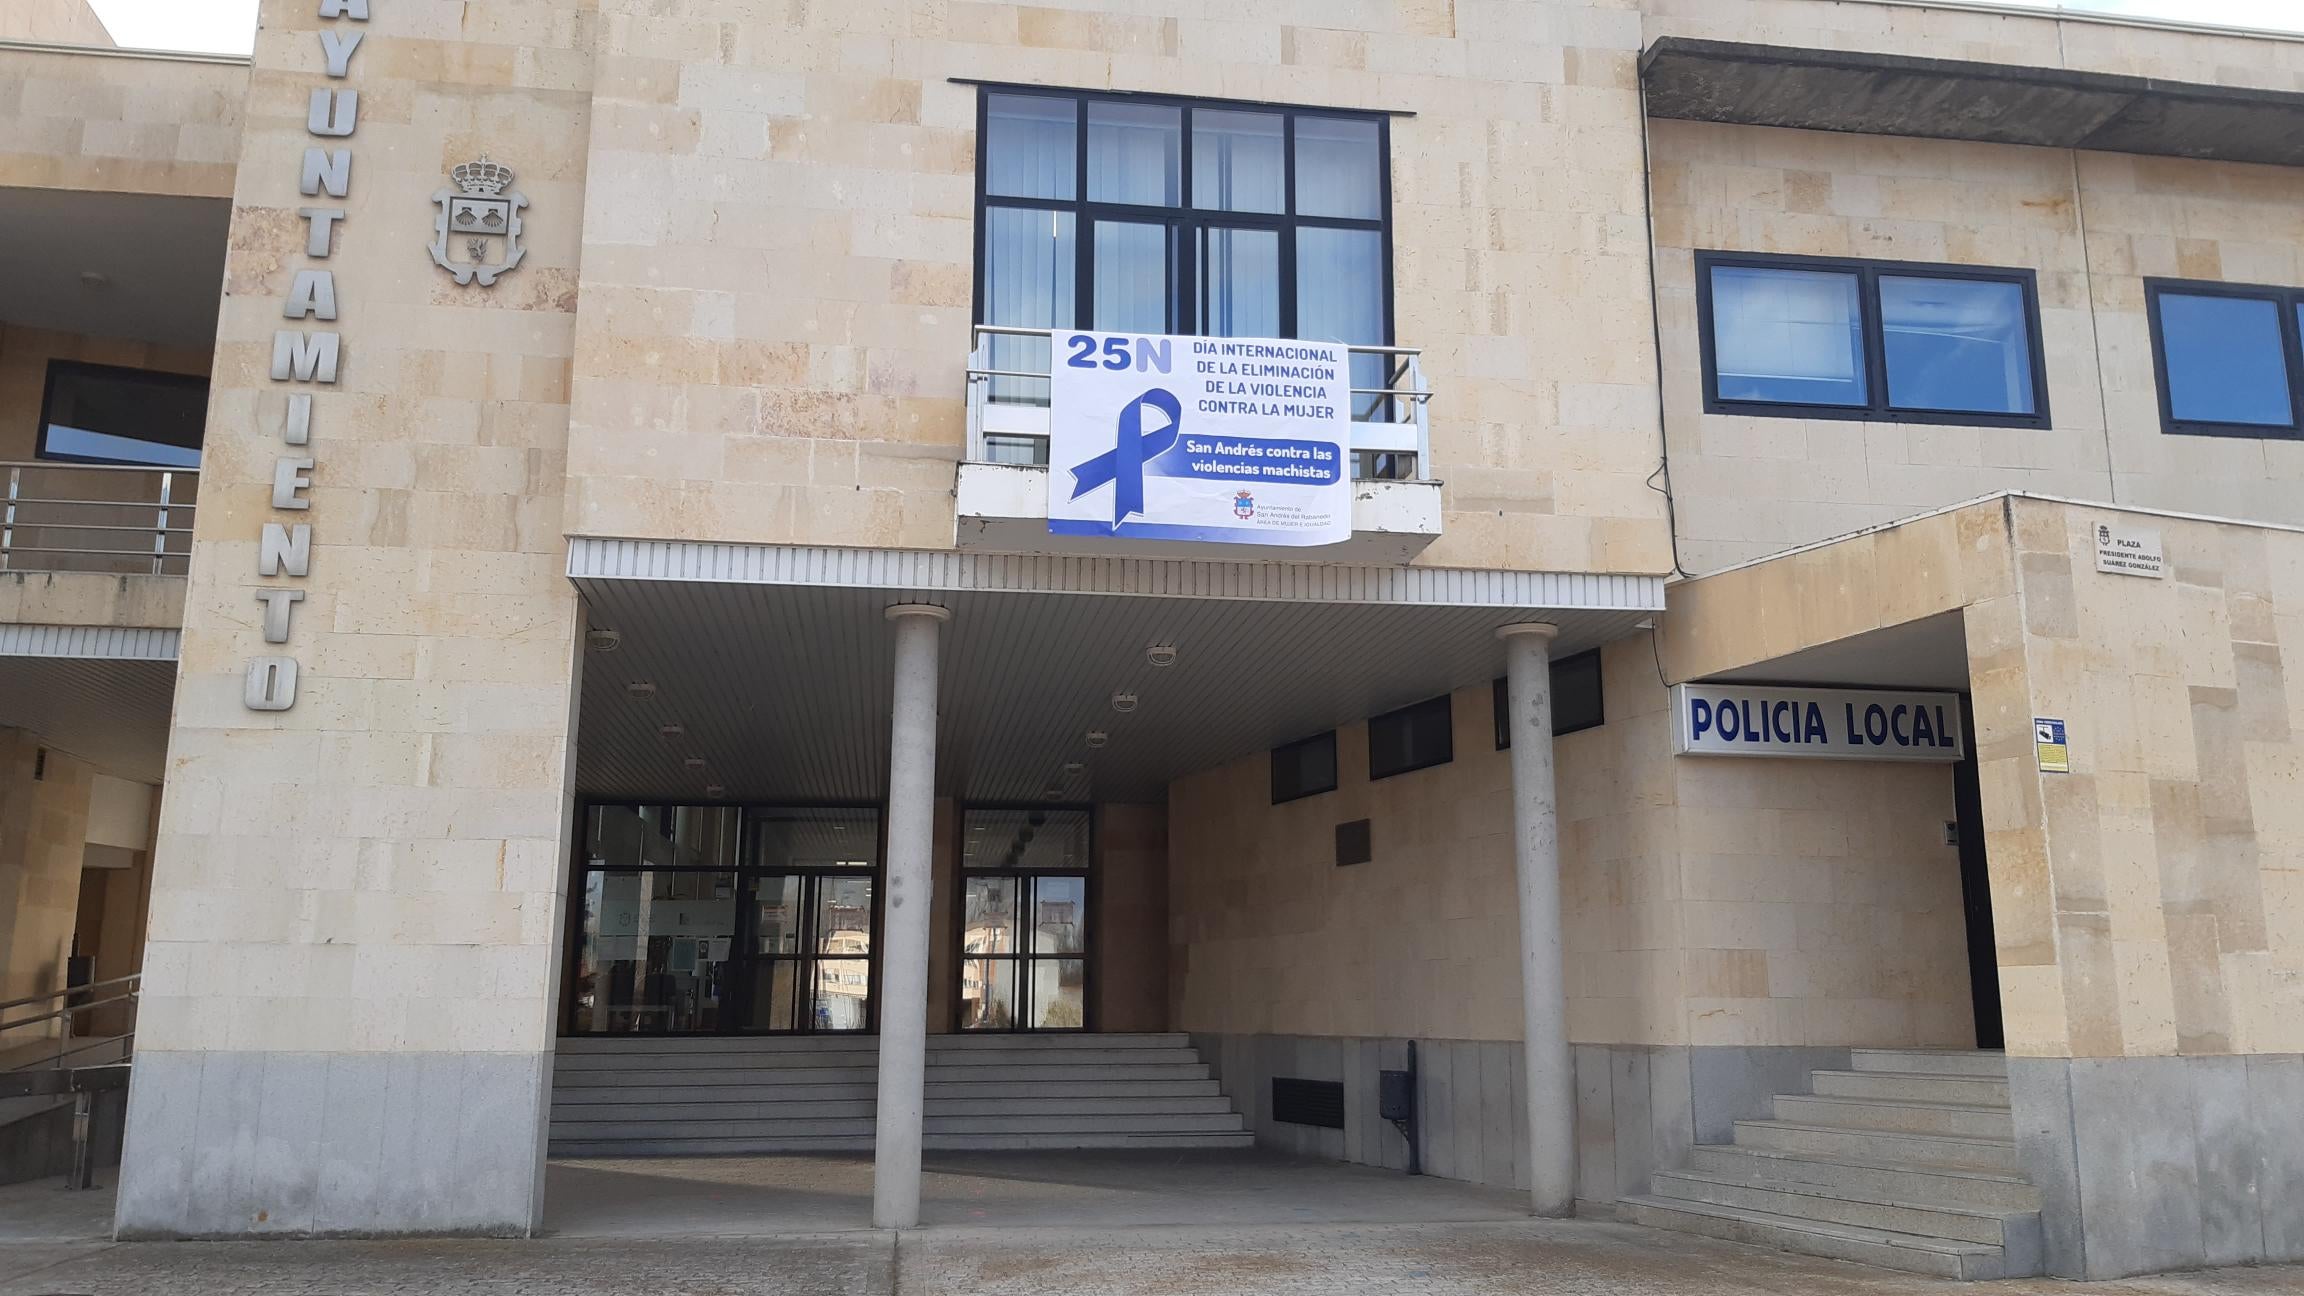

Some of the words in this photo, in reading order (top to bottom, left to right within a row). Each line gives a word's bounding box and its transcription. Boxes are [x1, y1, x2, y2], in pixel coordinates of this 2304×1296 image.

[1067, 334, 1172, 374] 25N
[1193, 340, 1217, 355] DÍA
[1221, 343, 1337, 362] INTERNACIONAL
[1197, 361, 1216, 374] DE
[1219, 362, 1238, 375] LA
[1241, 363, 1335, 380] ELIMINACIÓN
[1205, 380, 1225, 394] DE
[1228, 382, 1247, 395] LA
[1250, 383, 1327, 400] VIOLENCIA
[1199, 399, 1258, 415] CONTRA
[1261, 403, 1280, 416] LA
[1283, 404, 1334, 419] MUJER
[1186, 440, 1212, 454] San
[1215, 441, 1263, 457] Andrés
[1266, 446, 1310, 459] contra
[1313, 447, 1332, 460] las
[1192, 460, 1260, 475] violencias
[1262, 464, 1331, 479] machistas
[1256, 504, 1294, 513] Ayuntamiento
[2117, 539, 2141, 548] PLAZA
[1691, 698, 1828, 744] POLICIA
[1845, 702, 1954, 747] LOCAL
